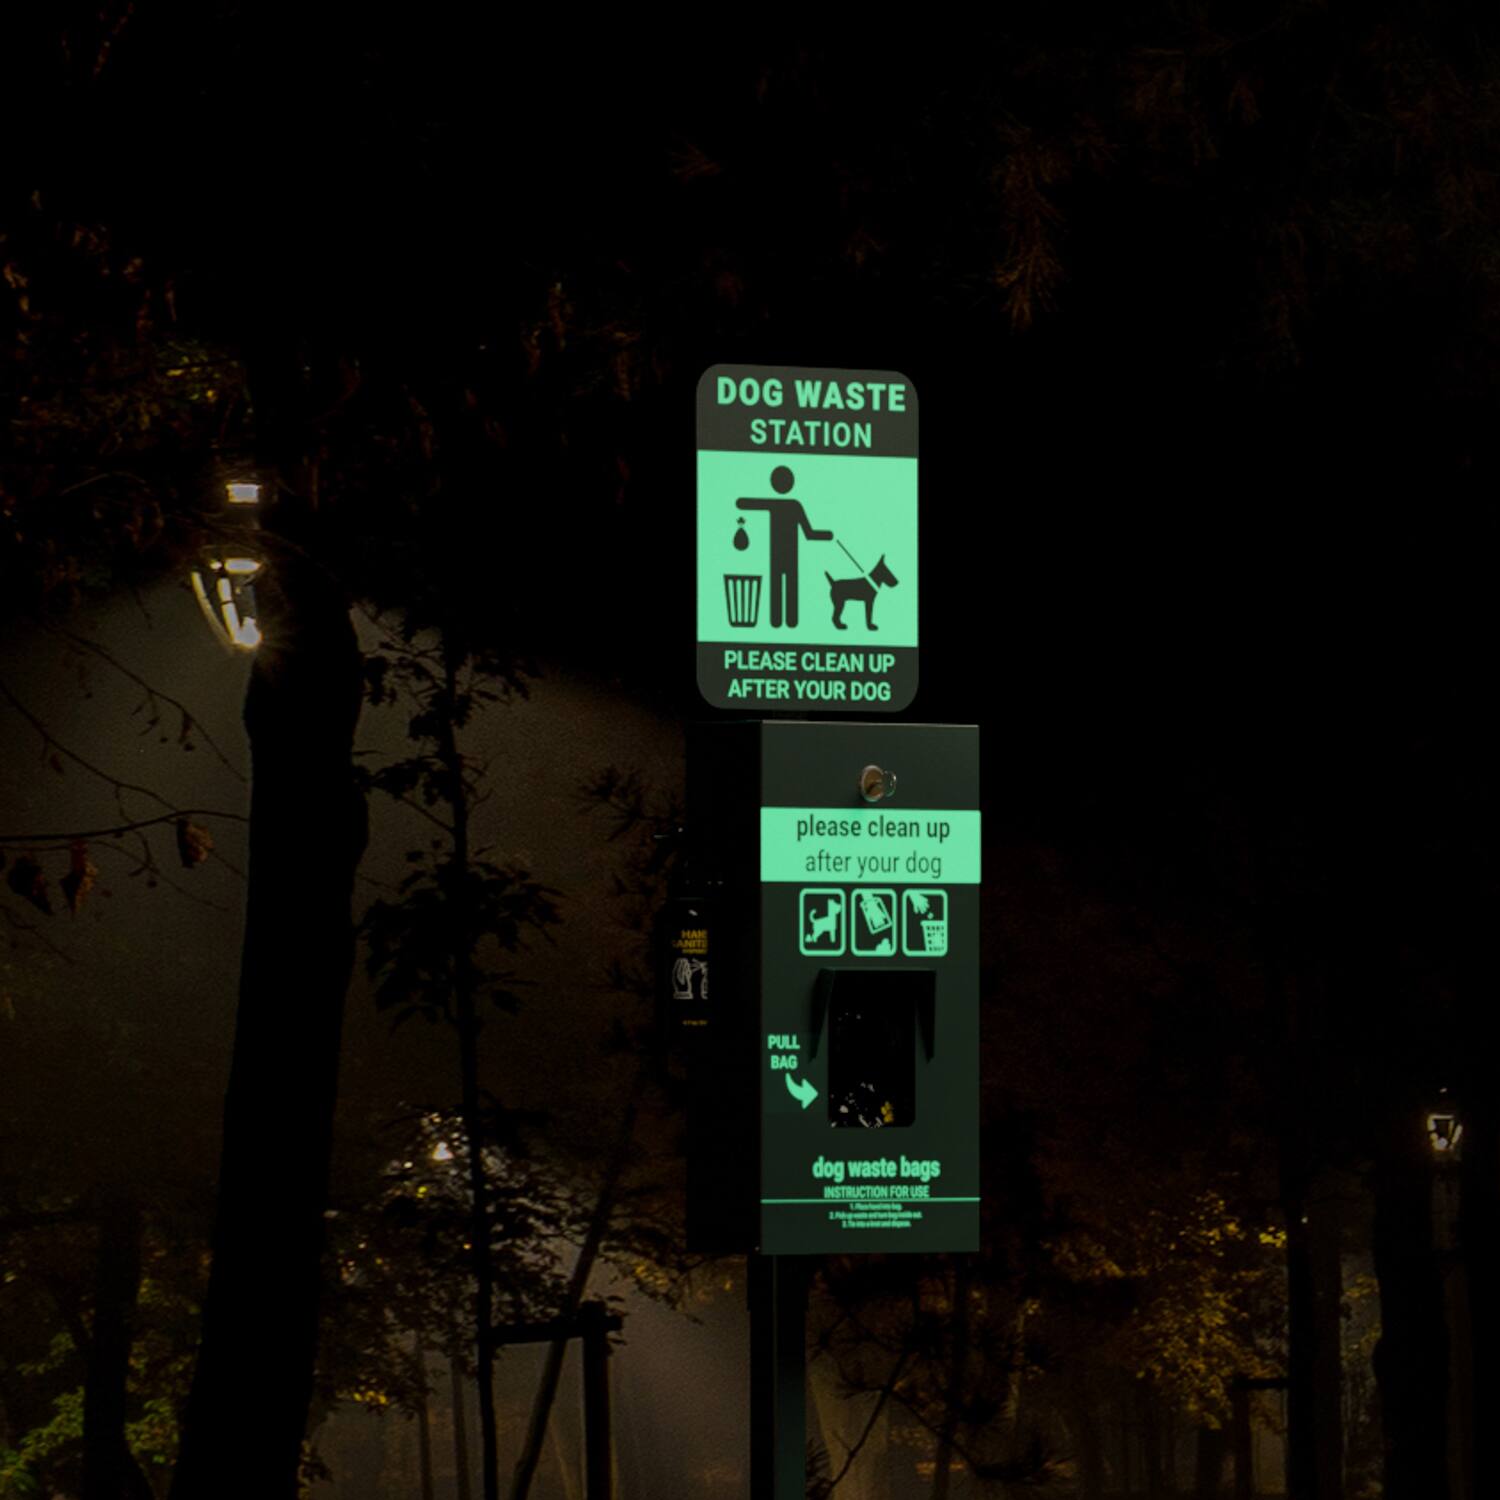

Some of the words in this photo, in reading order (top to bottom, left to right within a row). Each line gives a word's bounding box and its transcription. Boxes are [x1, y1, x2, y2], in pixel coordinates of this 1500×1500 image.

[718, 377, 783, 407] DOG
[795, 380, 906, 412] WASTE
[750, 419, 872, 448] STATION
[724, 650, 797, 672] PLEASE
[801, 652, 864, 673] CLEAN
[868, 654, 895, 673] UP
[727, 679, 789, 700] AFTER
[794, 680, 846, 700] YOUR
[850, 681, 891, 701] DOG
[797, 814, 862, 842] please
[867, 815, 920, 838] clean
[926, 821, 951, 844] up
[805, 849, 851, 873] after
[857, 855, 900, 879] your
[905, 850, 942, 879] dog
[767, 1034, 800, 1050] PULL
[770, 1055, 798, 1070] BAG
[812, 1155, 845, 1183] dog
[847, 1157, 898, 1178] waste
[900, 1155, 941, 1183] bags
[824, 1185, 888, 1199] INSTRUCTION
[890, 1185, 909, 1199] FOR
[910, 1185, 930, 1199] USE
